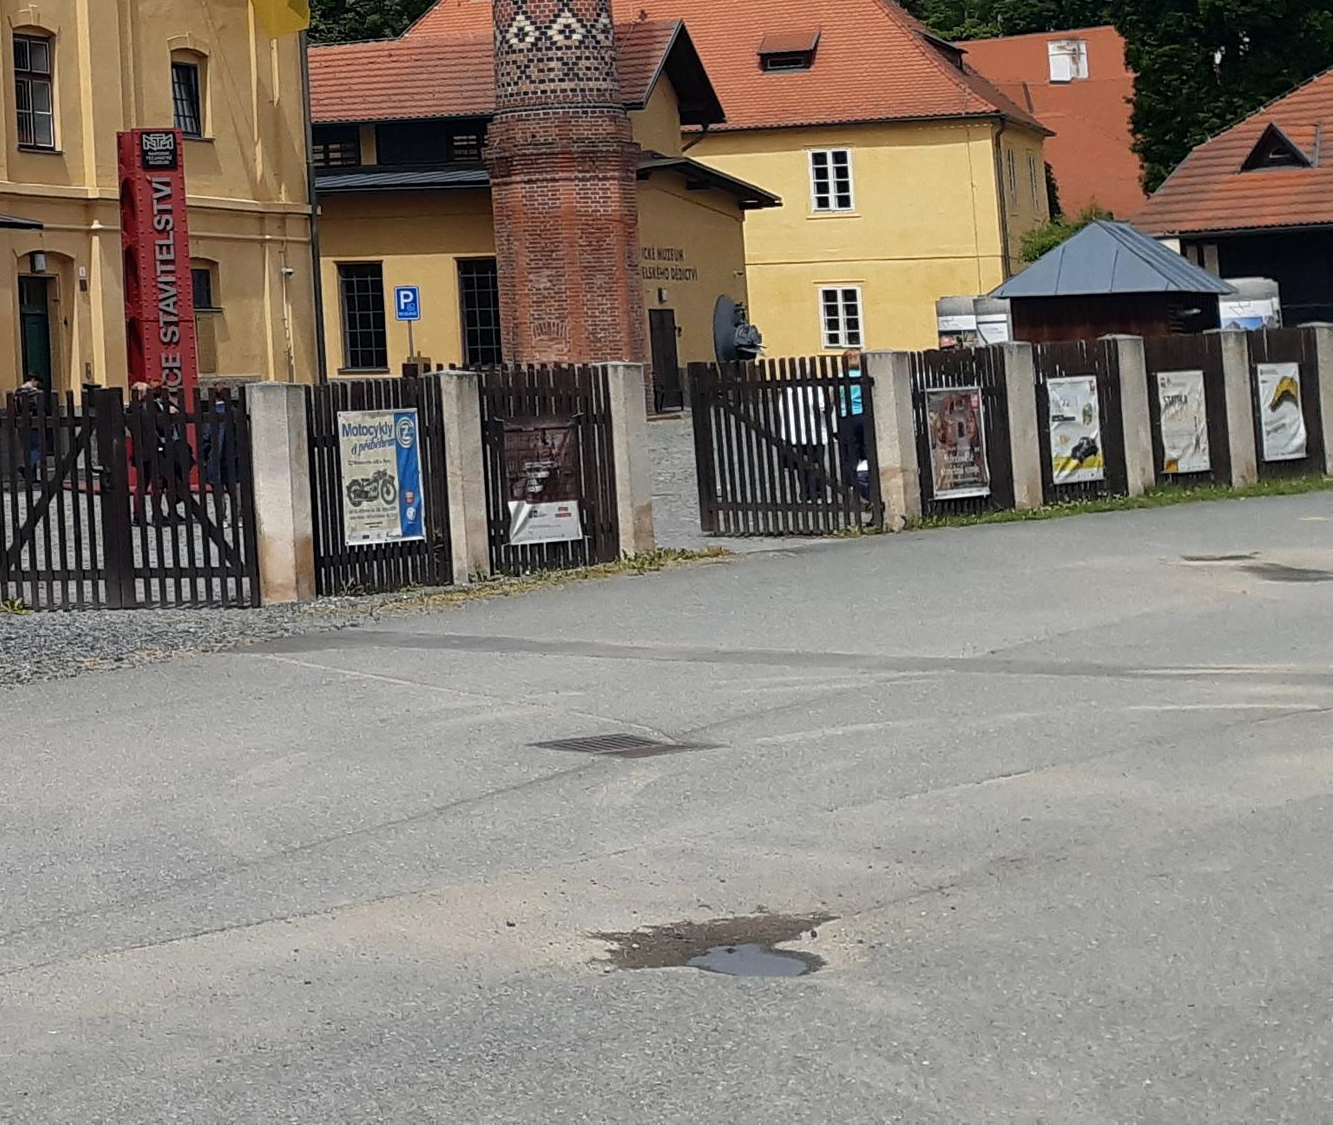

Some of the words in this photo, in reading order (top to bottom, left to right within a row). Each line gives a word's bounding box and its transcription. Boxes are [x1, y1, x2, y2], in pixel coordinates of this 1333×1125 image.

[146, 176, 182, 344] STAVITELSTVÍ
[400, 291, 414, 310] P
[342, 421, 393, 438] Motocykly
